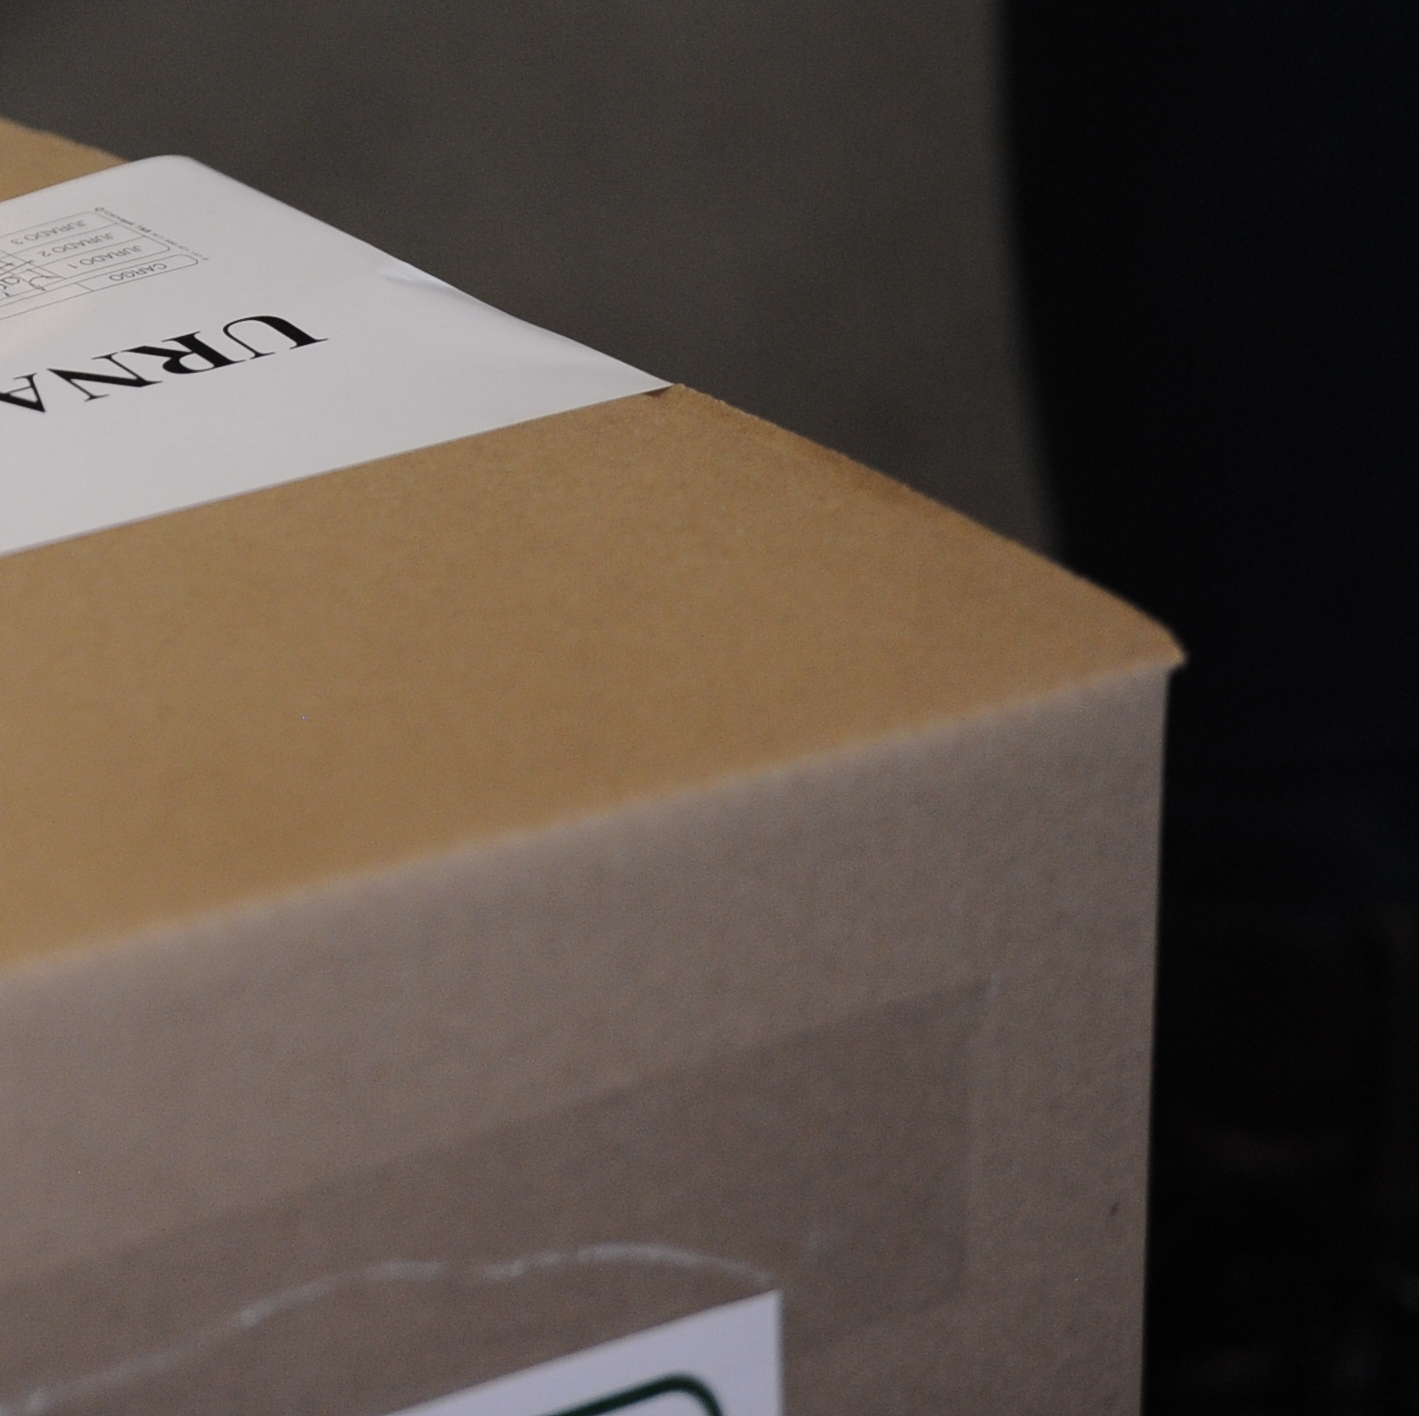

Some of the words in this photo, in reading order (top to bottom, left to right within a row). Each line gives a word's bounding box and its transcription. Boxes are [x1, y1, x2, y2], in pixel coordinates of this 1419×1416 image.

[24, 219, 87, 241] JURADO
[51, 232, 113, 253] JURADO
[79, 244, 142, 266] JURADO
[108, 262, 167, 282] CARGO
